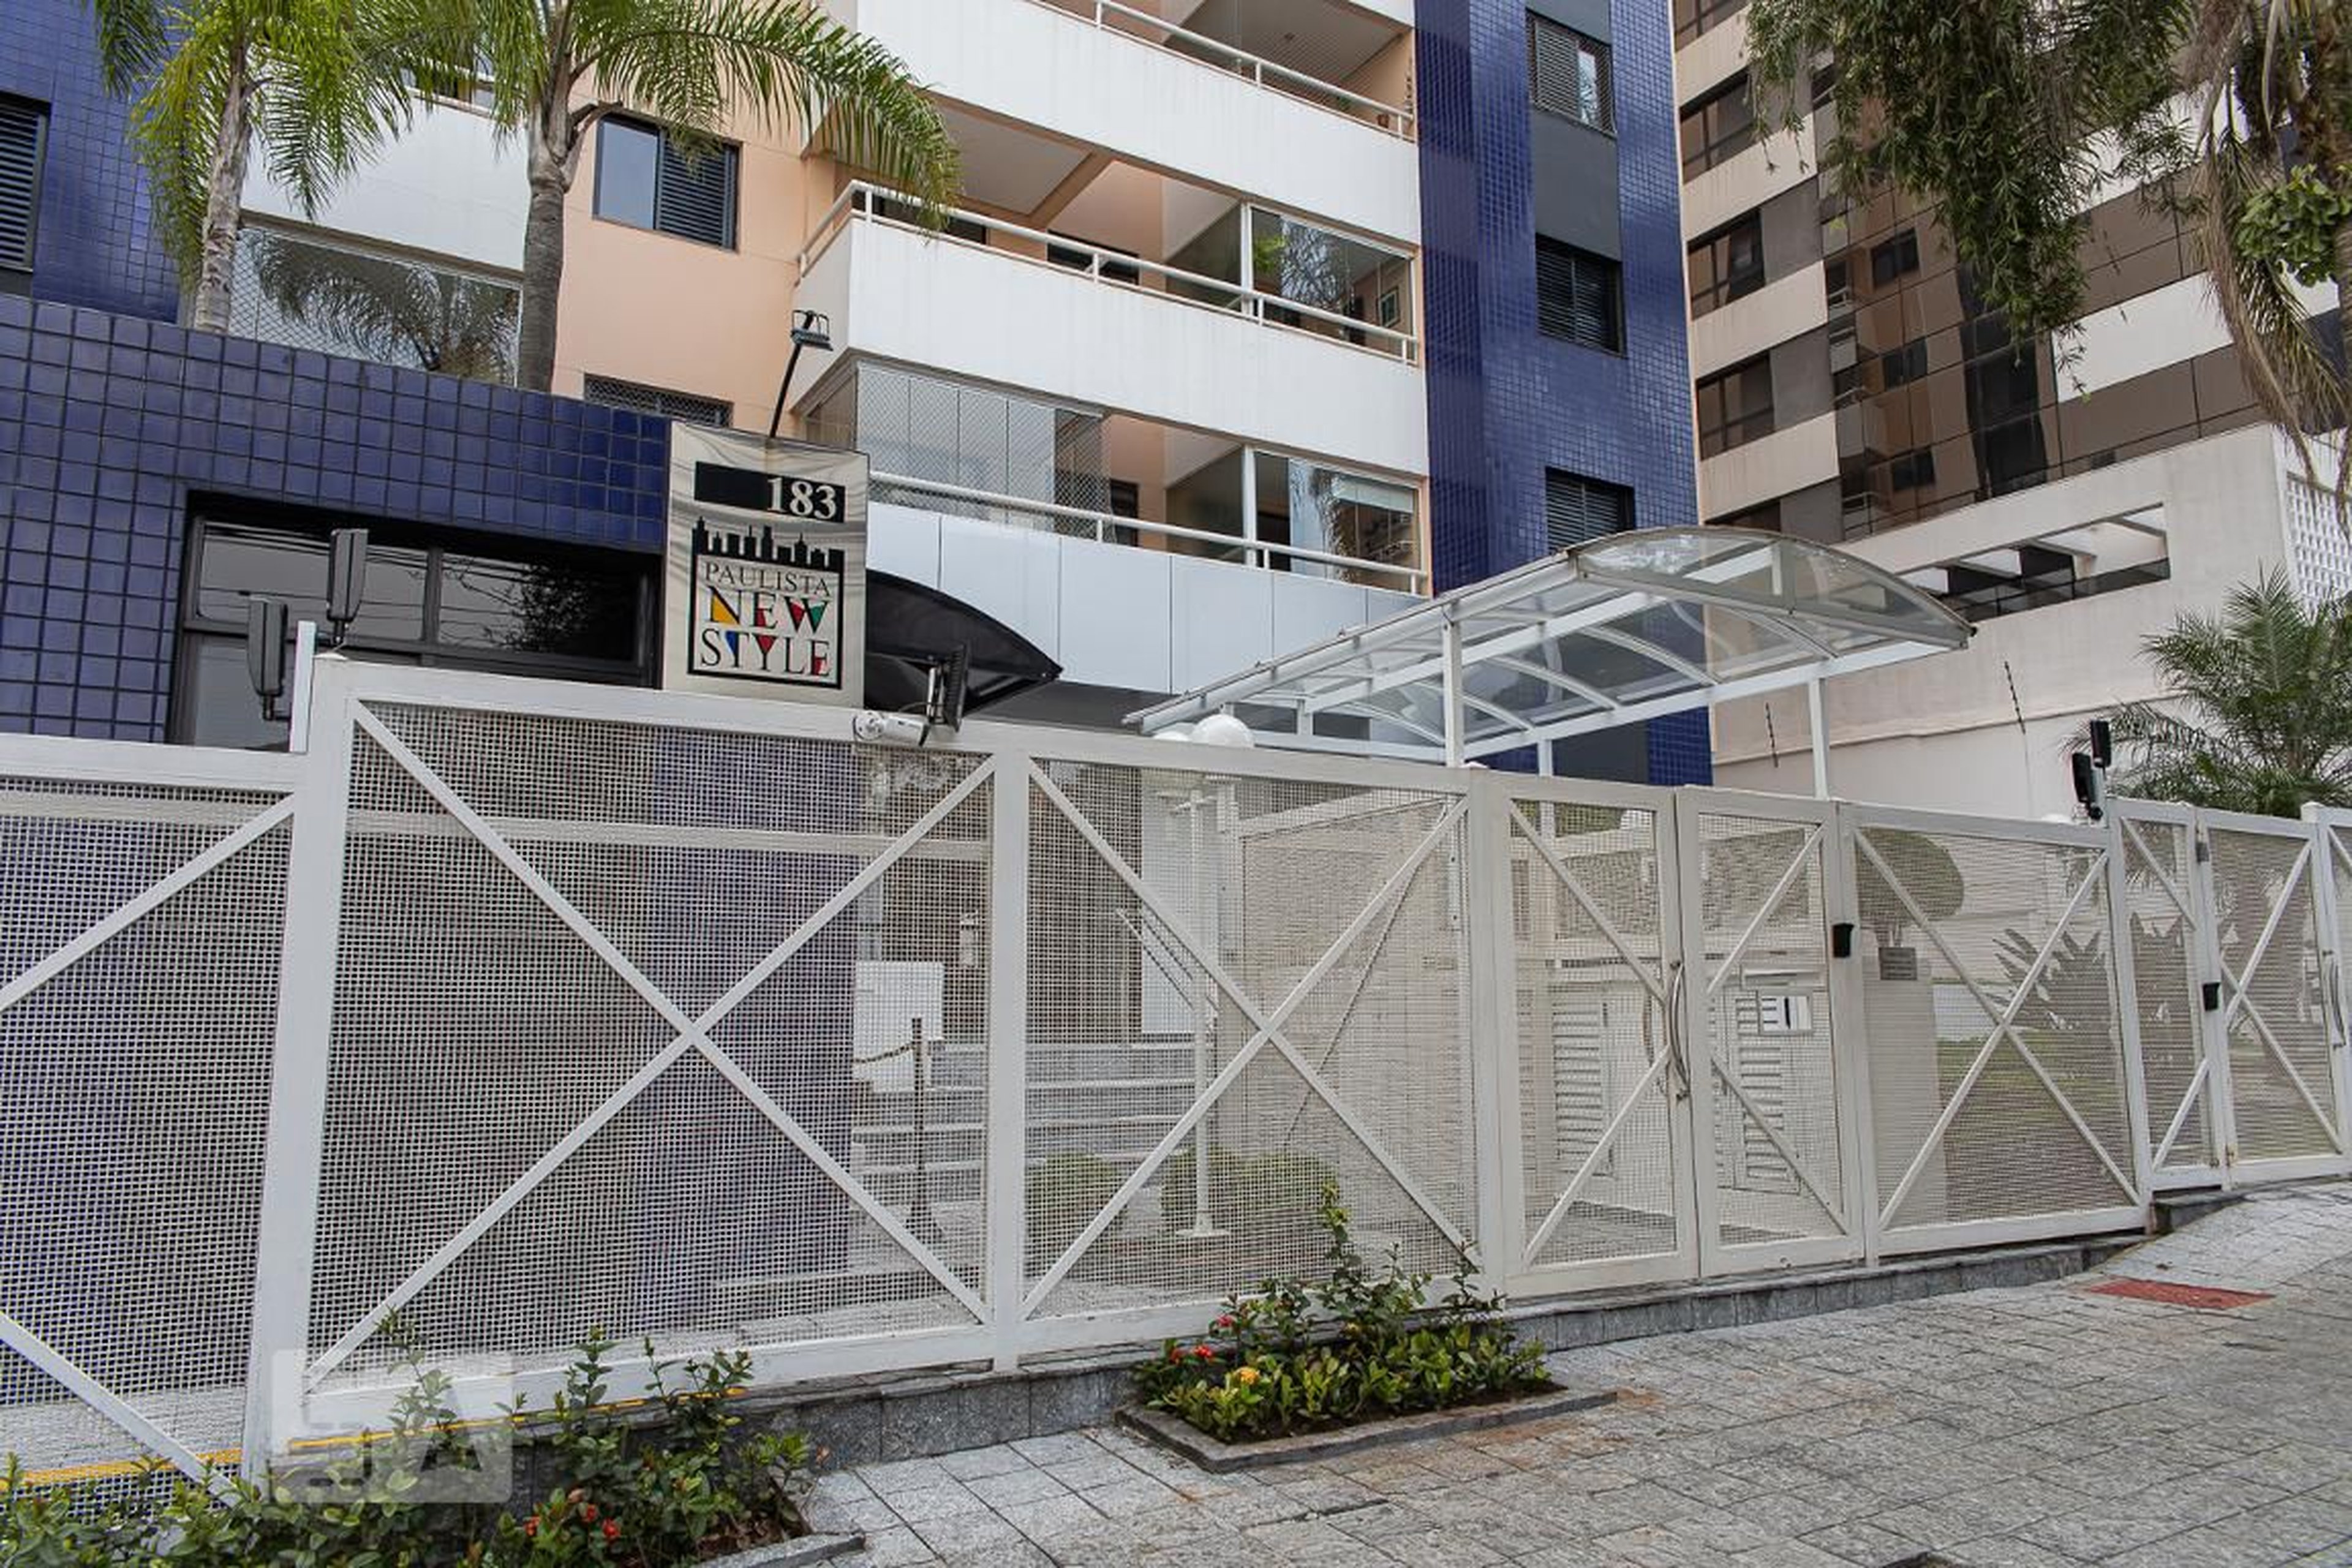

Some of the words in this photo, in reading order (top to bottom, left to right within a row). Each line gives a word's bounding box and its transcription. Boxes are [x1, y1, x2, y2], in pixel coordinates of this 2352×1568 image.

[767, 477, 837, 520] 183
[704, 562, 831, 597] PAULISTA
[709, 586, 830, 634] NEW
[701, 628, 831, 677] STYLE
